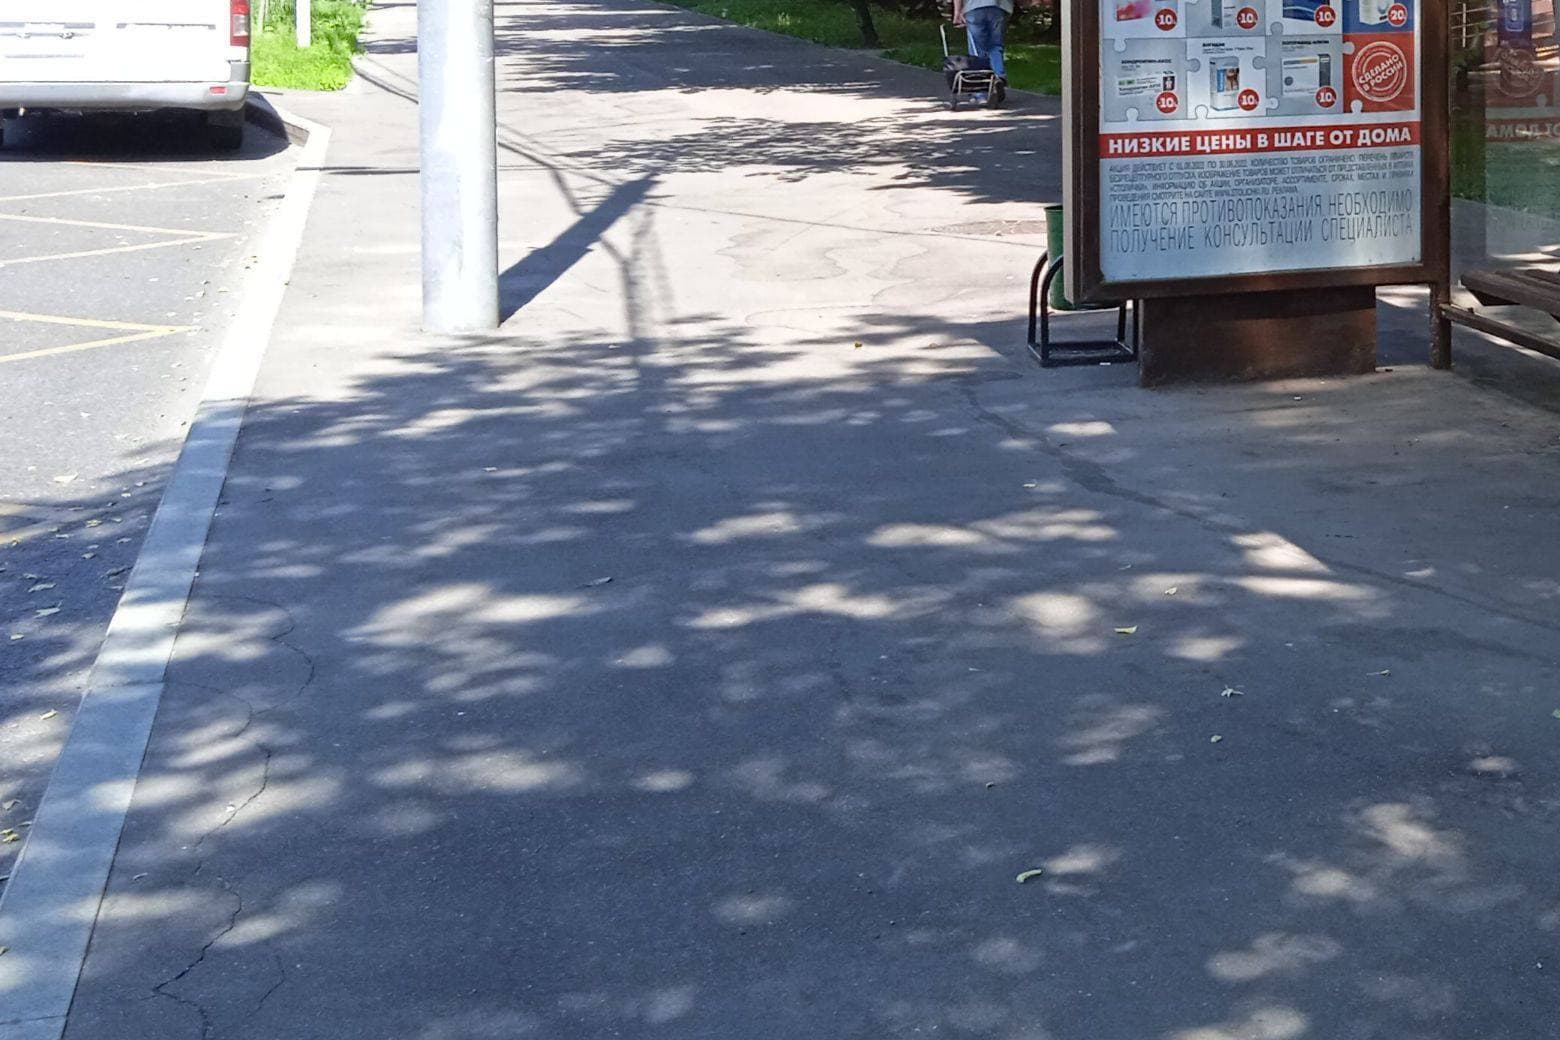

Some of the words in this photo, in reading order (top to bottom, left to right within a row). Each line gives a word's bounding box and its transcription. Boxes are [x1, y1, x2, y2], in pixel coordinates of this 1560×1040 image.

[1358, 54, 1399, 84] СДЕЛАНО
[1362, 84, 1370, 92] В
[1369, 61, 1404, 86] РОССИИ
[1108, 136, 1191, 154] НИЗКИЕ
[1196, 134, 1251, 152] ЦЕНЫ
[1257, 133, 1268, 148] В
[1274, 131, 1325, 147] ШАГЕ
[1329, 130, 1354, 145] ОТ
[1357, 127, 1411, 147] ДОМА
[1110, 201, 1178, 228] ИМЕЮТСЯ
[1328, 188, 1413, 217] НЕОБХОДИМО
[1110, 225, 1195, 253] ПОЛУЧЕНИЕ
[1204, 219, 1313, 248] КОНСУЛЬТАЦИИ
[1322, 213, 1413, 243] СПЕЦИАЛИСТА
